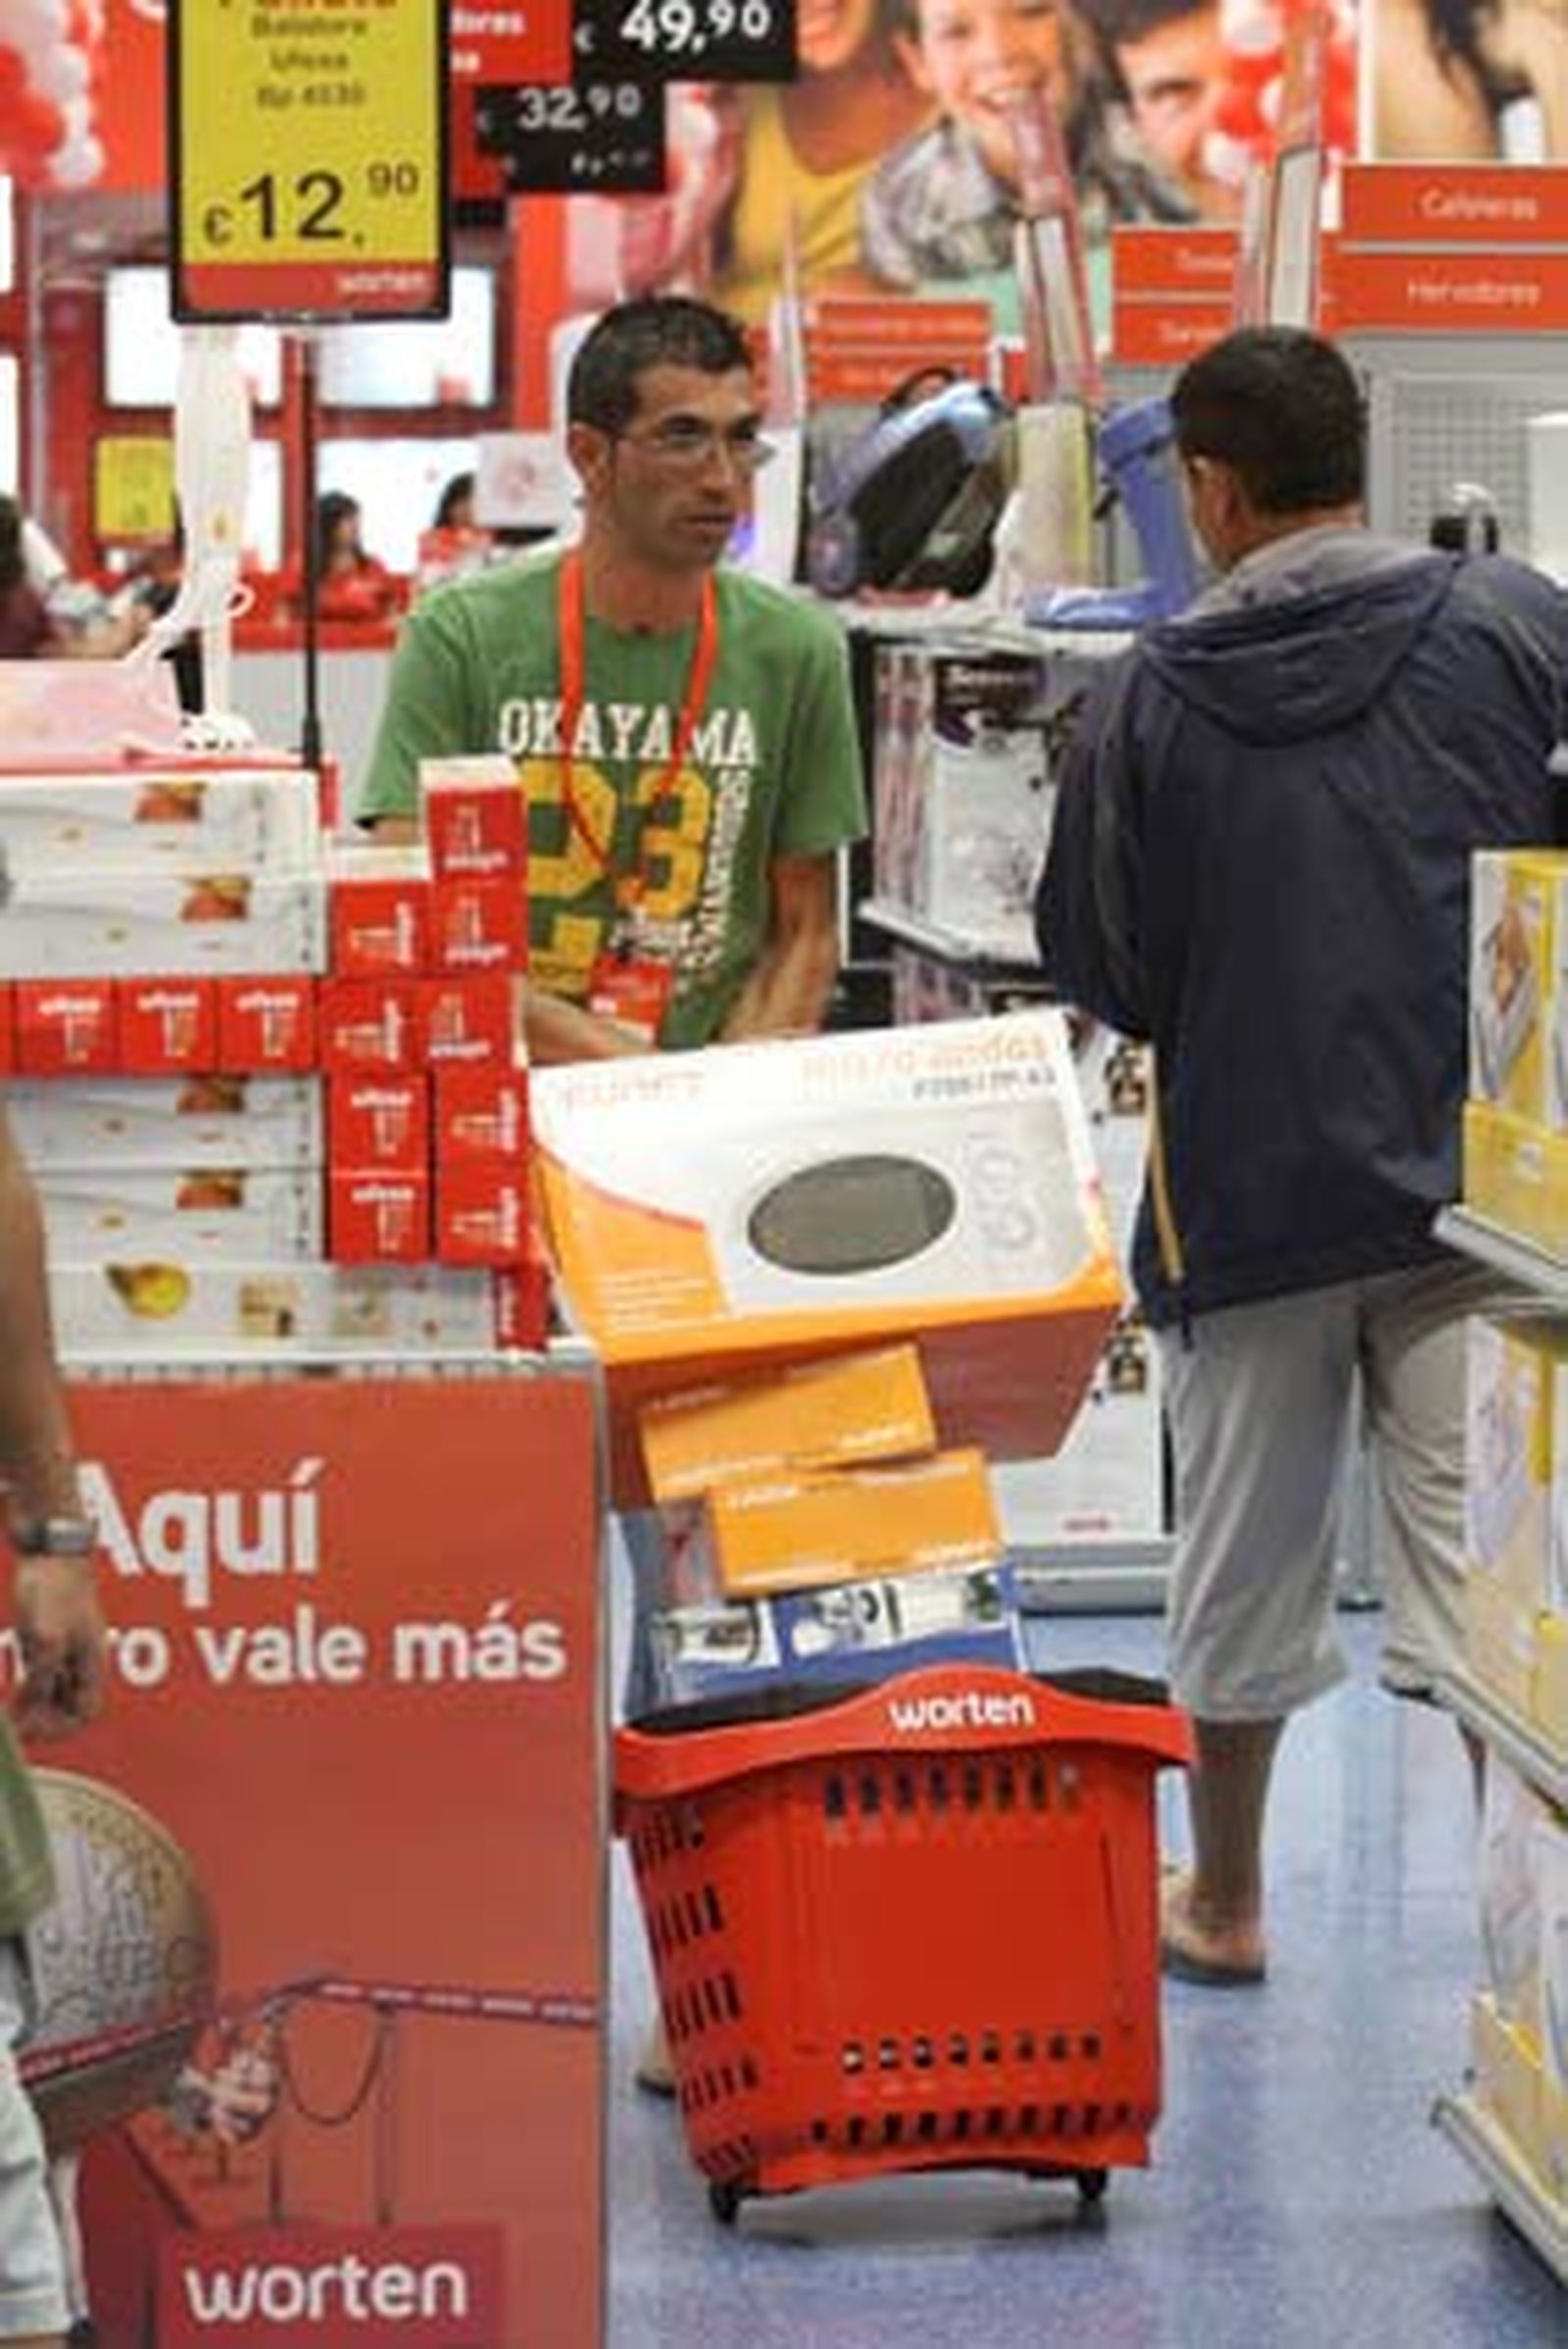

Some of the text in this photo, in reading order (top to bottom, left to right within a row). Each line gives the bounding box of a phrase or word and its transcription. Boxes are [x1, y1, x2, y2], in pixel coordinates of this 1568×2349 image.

[620, 0, 771, 51] 49,90
[499, 699, 758, 766] OKAYAMA
[76, 1457, 327, 1609] Aquí
[195, 1603, 367, 1686] vale
[392, 1600, 568, 1682] más
[890, 1690, 1036, 1733] worten
[183, 2255, 468, 2324] worten
